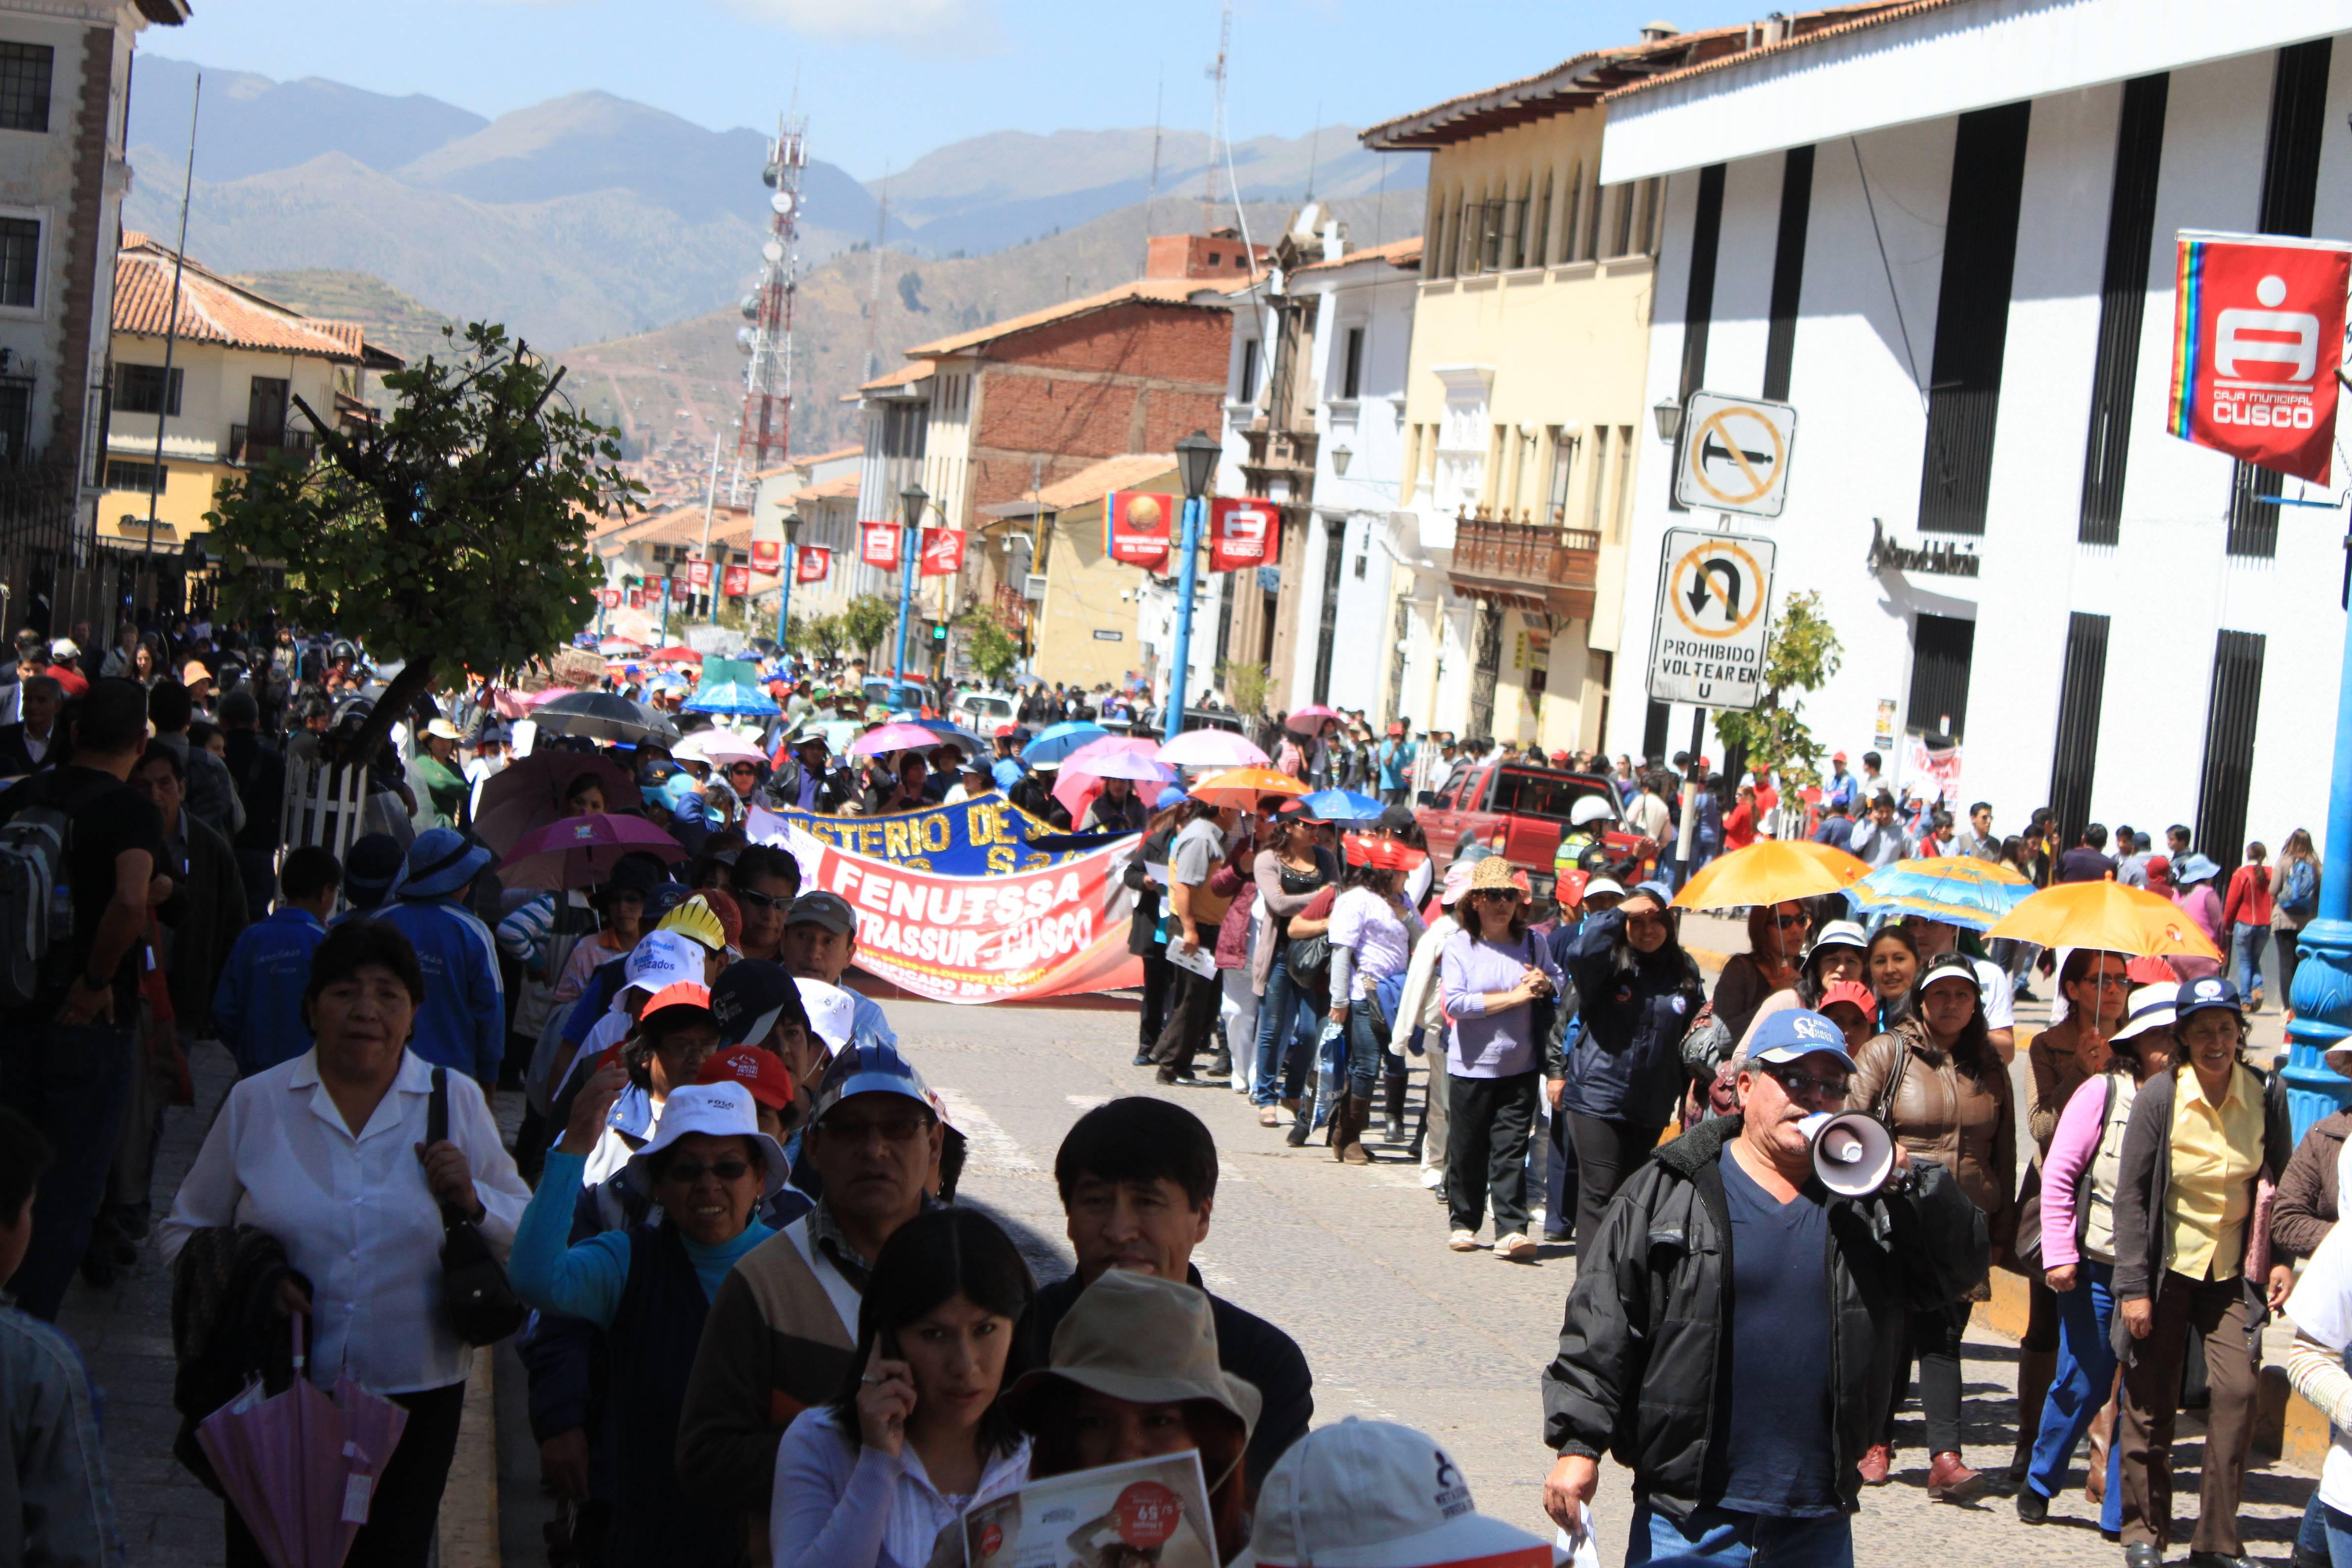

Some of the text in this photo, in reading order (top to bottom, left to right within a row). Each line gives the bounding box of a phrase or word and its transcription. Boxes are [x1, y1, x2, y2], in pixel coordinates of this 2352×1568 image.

[2214, 390, 2313, 406] CAJA MUNICIPAL
[2213, 401, 2313, 429] CUSCO
[1222, 545, 1264, 557] CUSCO
[1664, 639, 1755, 664] PROHIBIDO
[1663, 658, 1757, 684] VOLTEAR EN
[1698, 682, 1712, 699] U
[967, 799, 1017, 847] DE
[1000, 907, 1092, 966] CUSCO
[707, 1099, 734, 1108] POLO
[1138, 1505, 1158, 1521] 59
